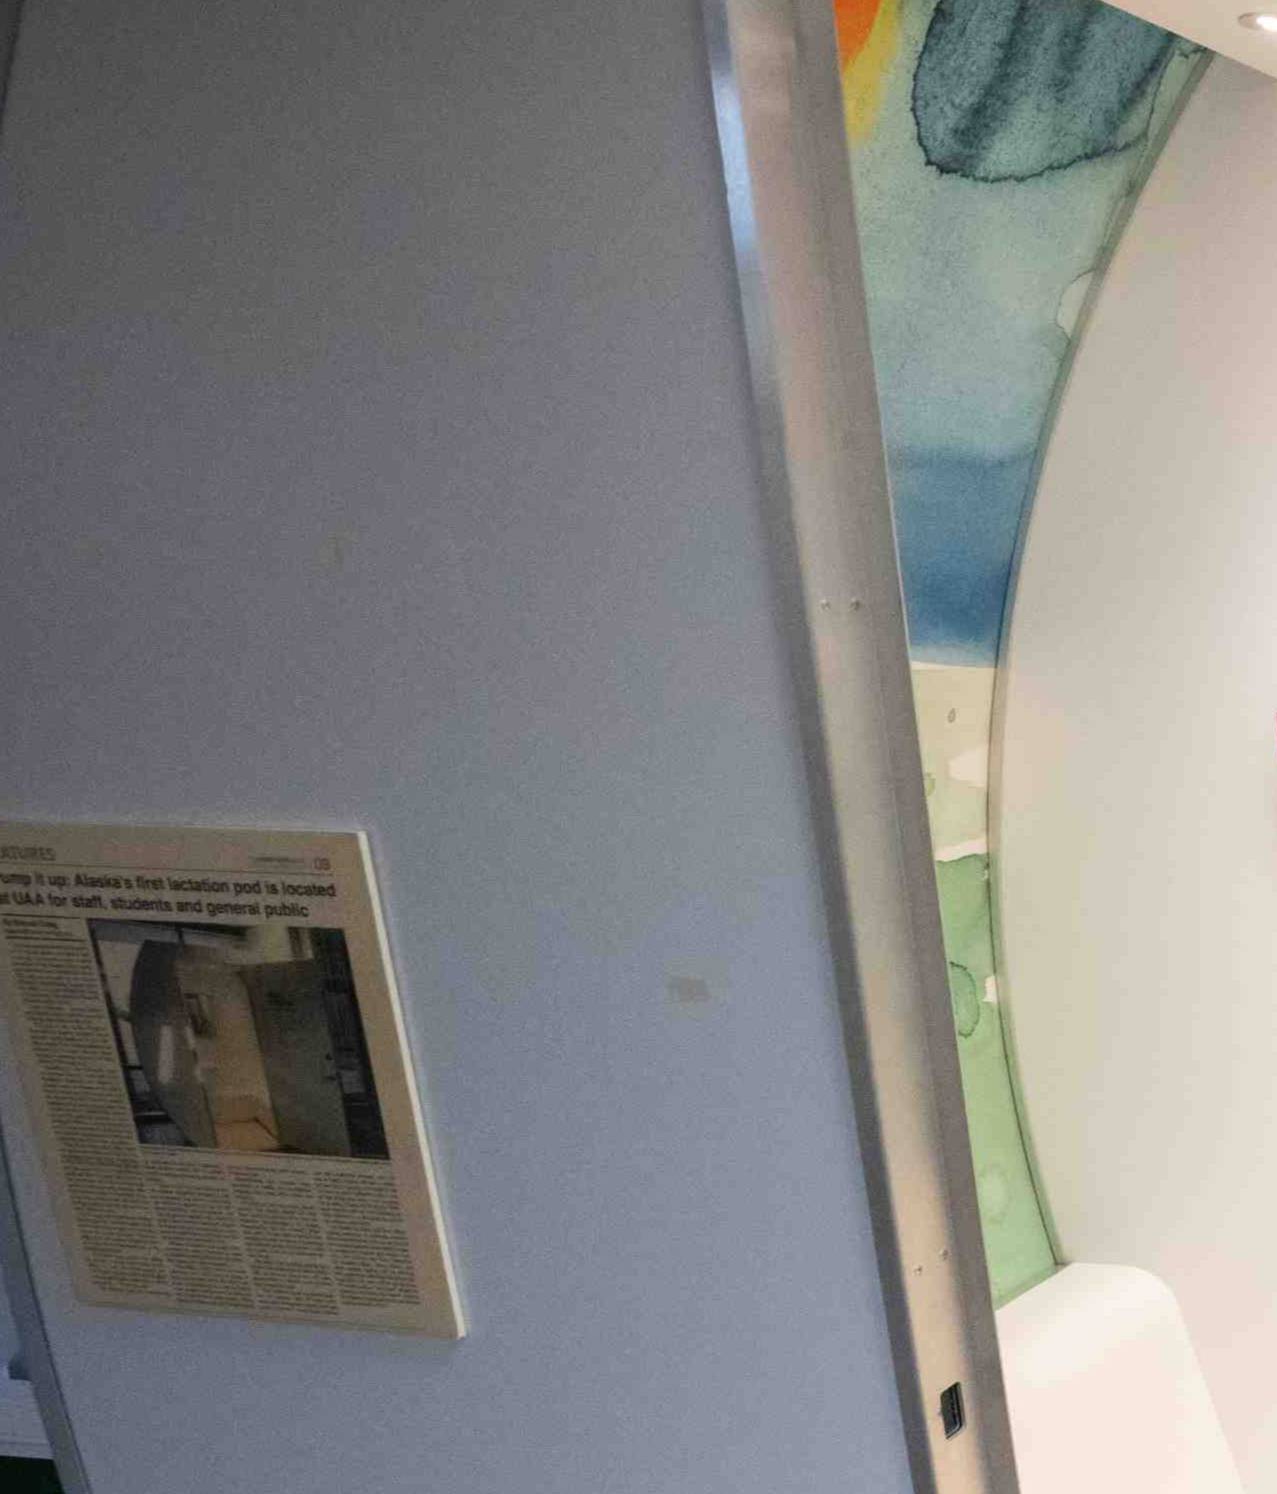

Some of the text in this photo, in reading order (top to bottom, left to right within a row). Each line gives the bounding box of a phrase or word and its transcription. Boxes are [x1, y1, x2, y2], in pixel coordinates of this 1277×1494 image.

[0, 873, 32, 888] ump
[74, 873, 133, 889] Alaska's
[136, 875, 165, 890] first
[168, 876, 229, 893] lactation
[233, 879, 262, 896] pod
[265, 880, 279, 895] is
[281, 880, 336, 898] located
[48, 893, 68, 907] for
[110, 896, 173, 912] students
[176, 899, 202, 914] and
[206, 900, 260, 917] general
[265, 902, 310, 919] public
